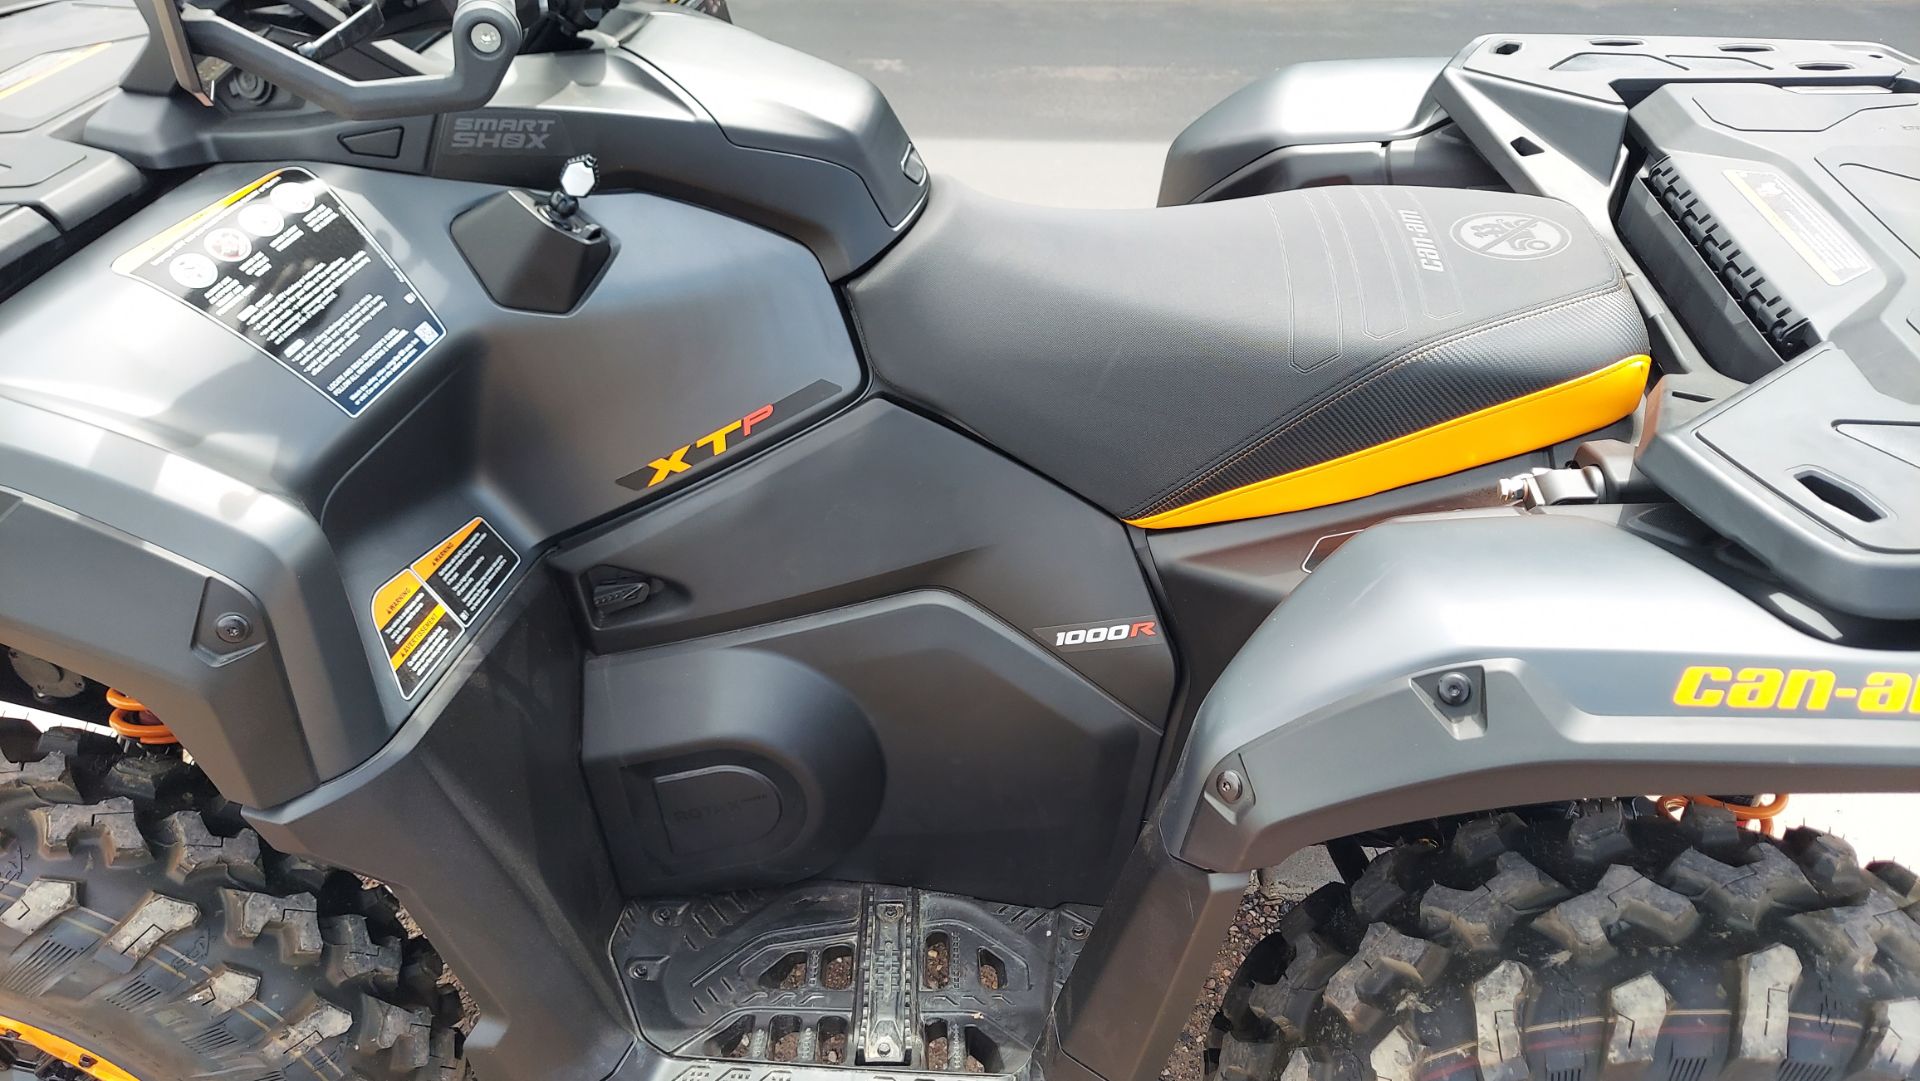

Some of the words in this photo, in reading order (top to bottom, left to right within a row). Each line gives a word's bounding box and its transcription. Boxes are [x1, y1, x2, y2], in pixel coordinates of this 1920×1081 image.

[451, 132, 551, 149] SHOX
[453, 117, 556, 132] SMART
[1398, 208, 1444, 272] can-am
[646, 403, 775, 488] XTP
[1055, 621, 1157, 647] 1000R
[1672, 665, 1920, 715] can-a
